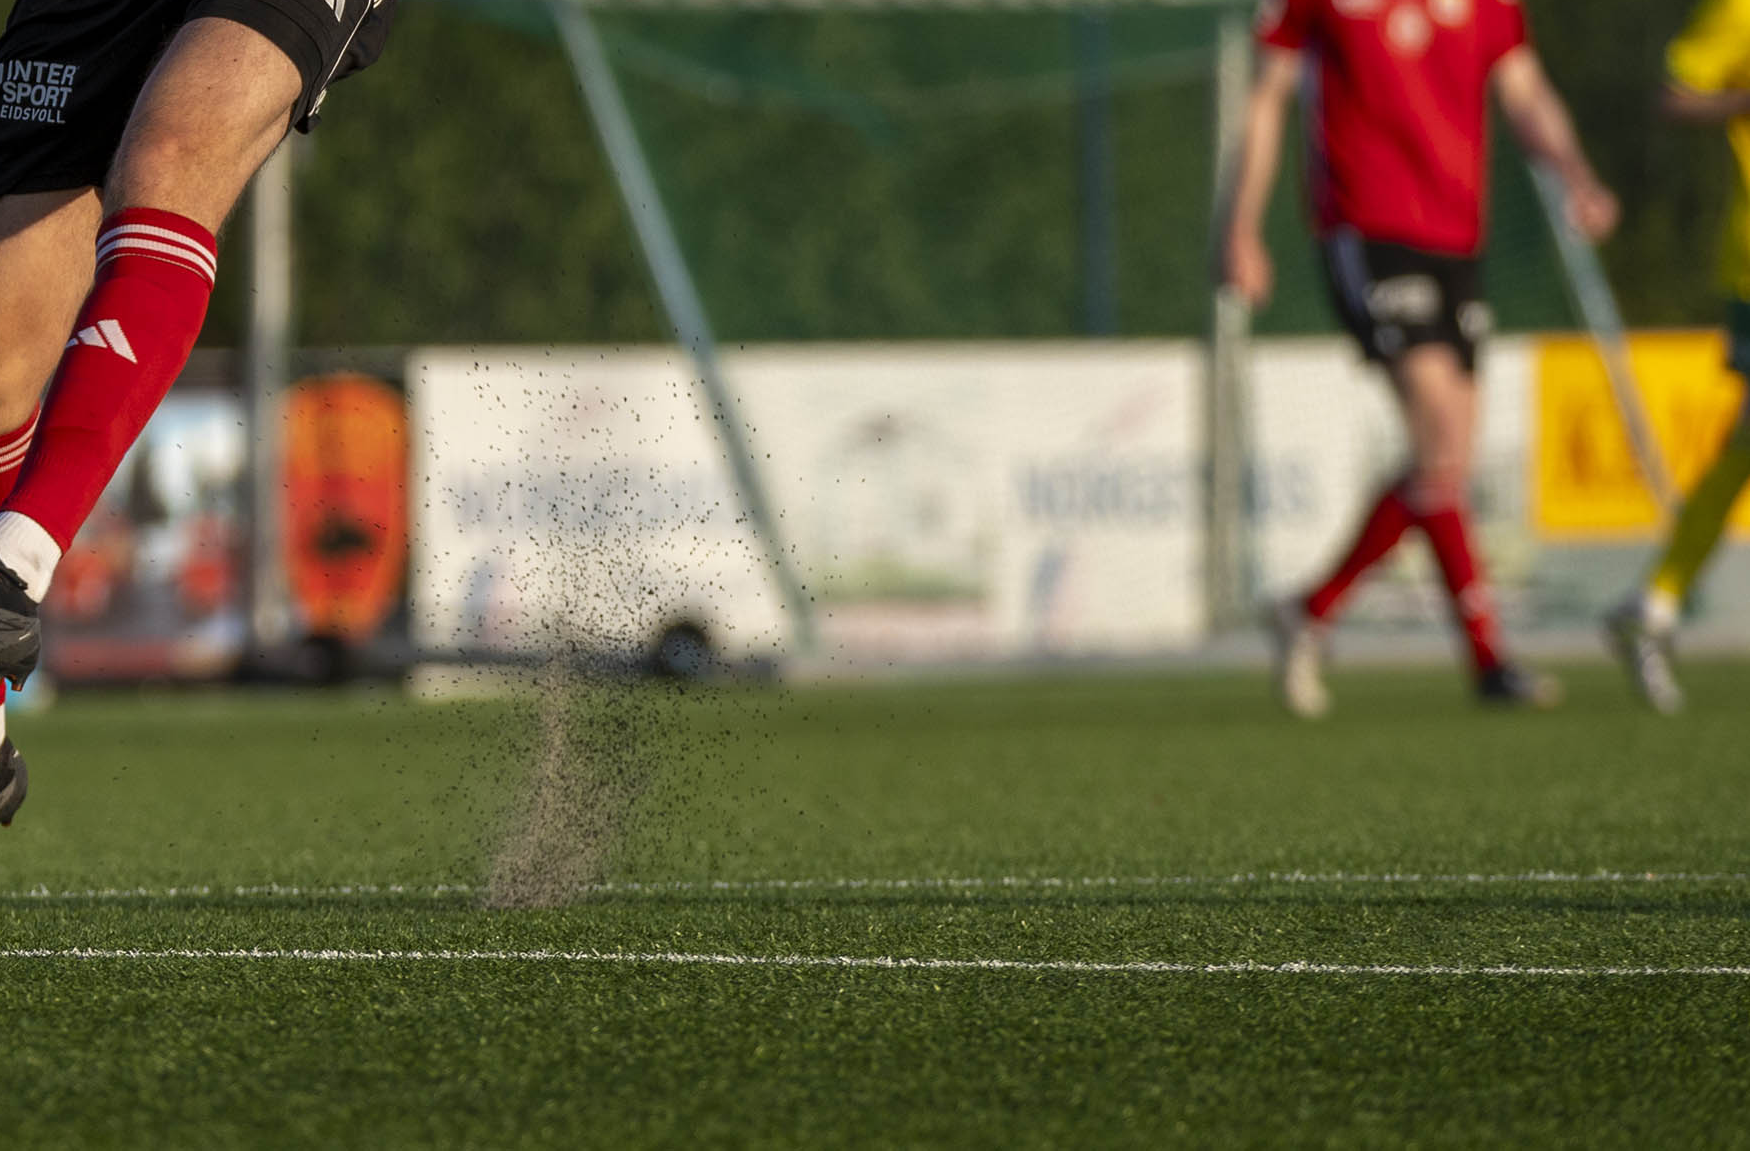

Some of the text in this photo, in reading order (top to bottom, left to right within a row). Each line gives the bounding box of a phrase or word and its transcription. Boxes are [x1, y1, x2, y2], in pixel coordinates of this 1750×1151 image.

[7, 60, 76, 85] INTER
[2, 81, 72, 107] SPORT
[0, 104, 66, 123] EIDSVOLL
